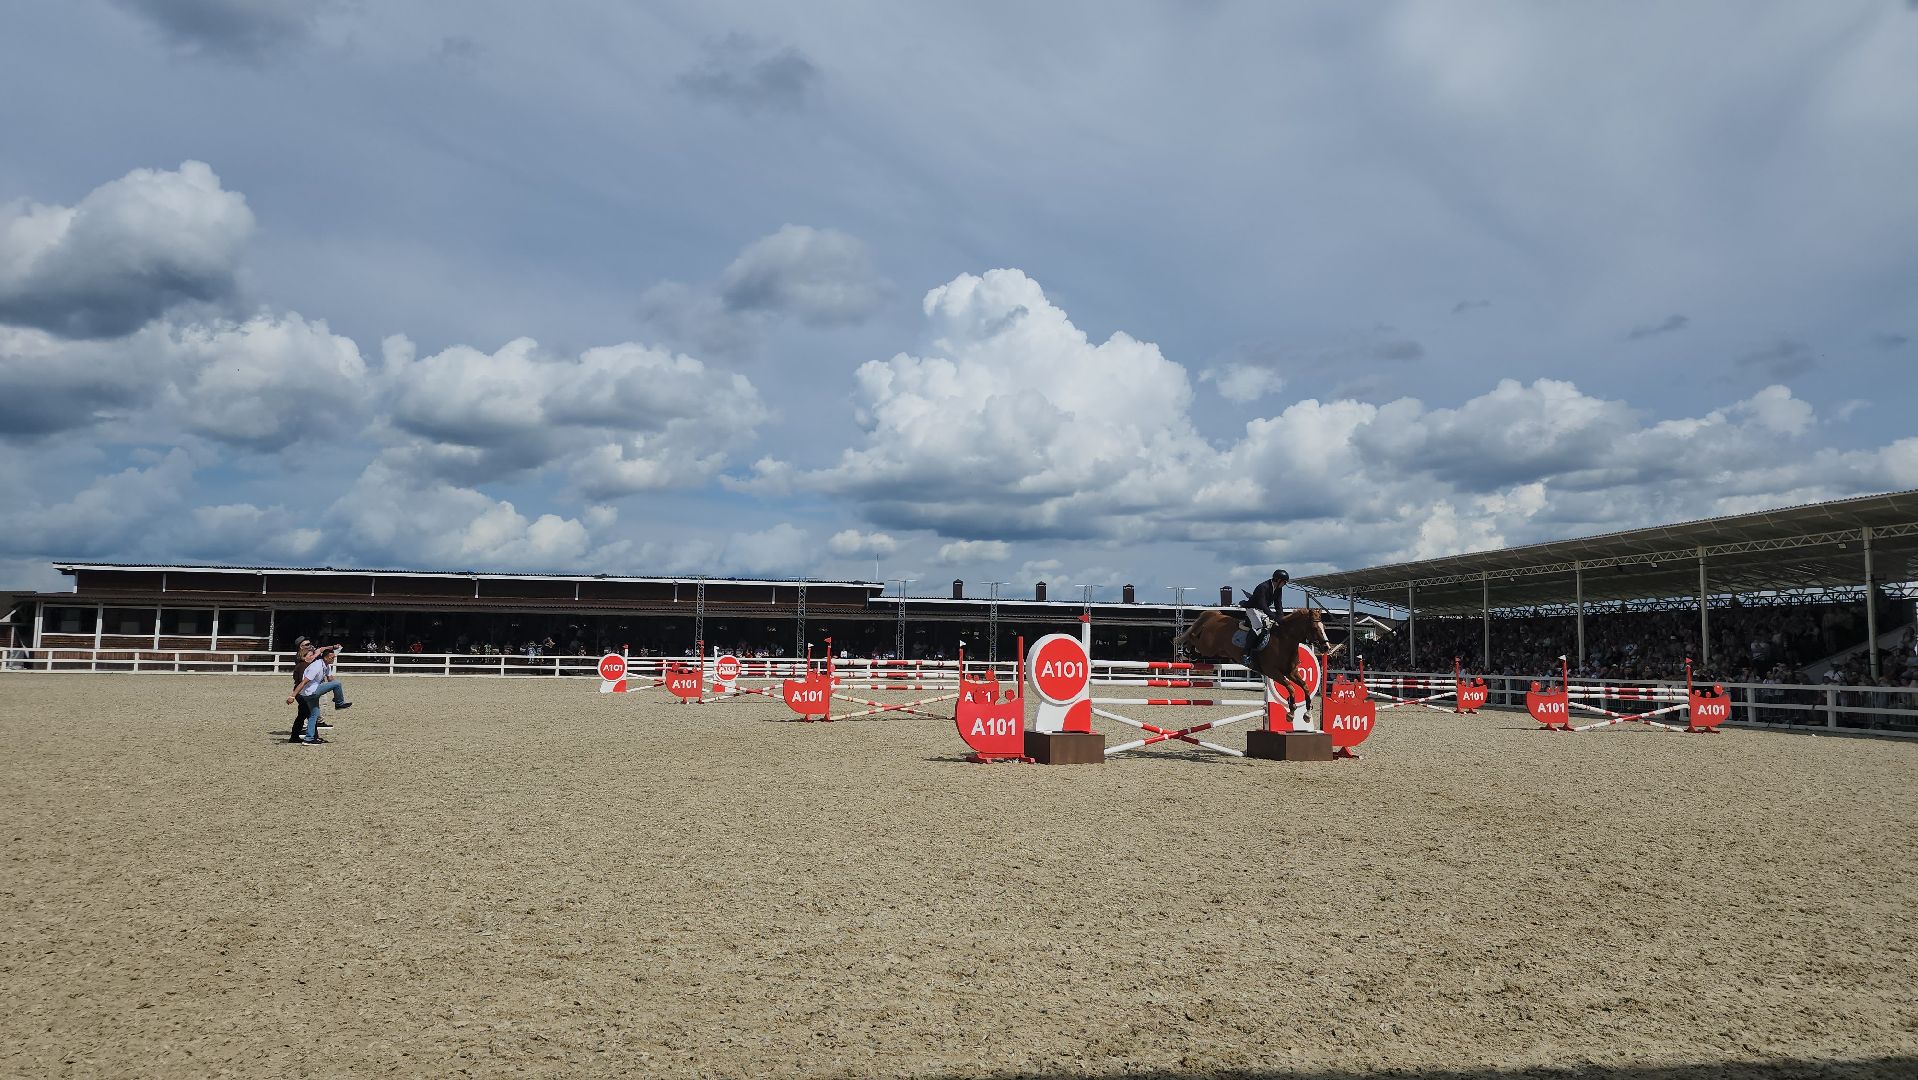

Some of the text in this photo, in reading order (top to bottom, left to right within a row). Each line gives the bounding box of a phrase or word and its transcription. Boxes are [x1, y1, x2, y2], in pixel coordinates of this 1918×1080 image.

[602, 664, 623, 672] A101
[1041, 660, 1083, 678] A101
[1297, 667, 1313, 682] 01
[671, 679, 698, 689] A101
[791, 689, 823, 703] A101
[964, 690, 991, 703] A1
[1463, 691, 1484, 701] A101
[1537, 702, 1565, 713] A101
[1697, 704, 1725, 716] A101
[970, 717, 1016, 736] A101
[1332, 714, 1368, 731] A101
